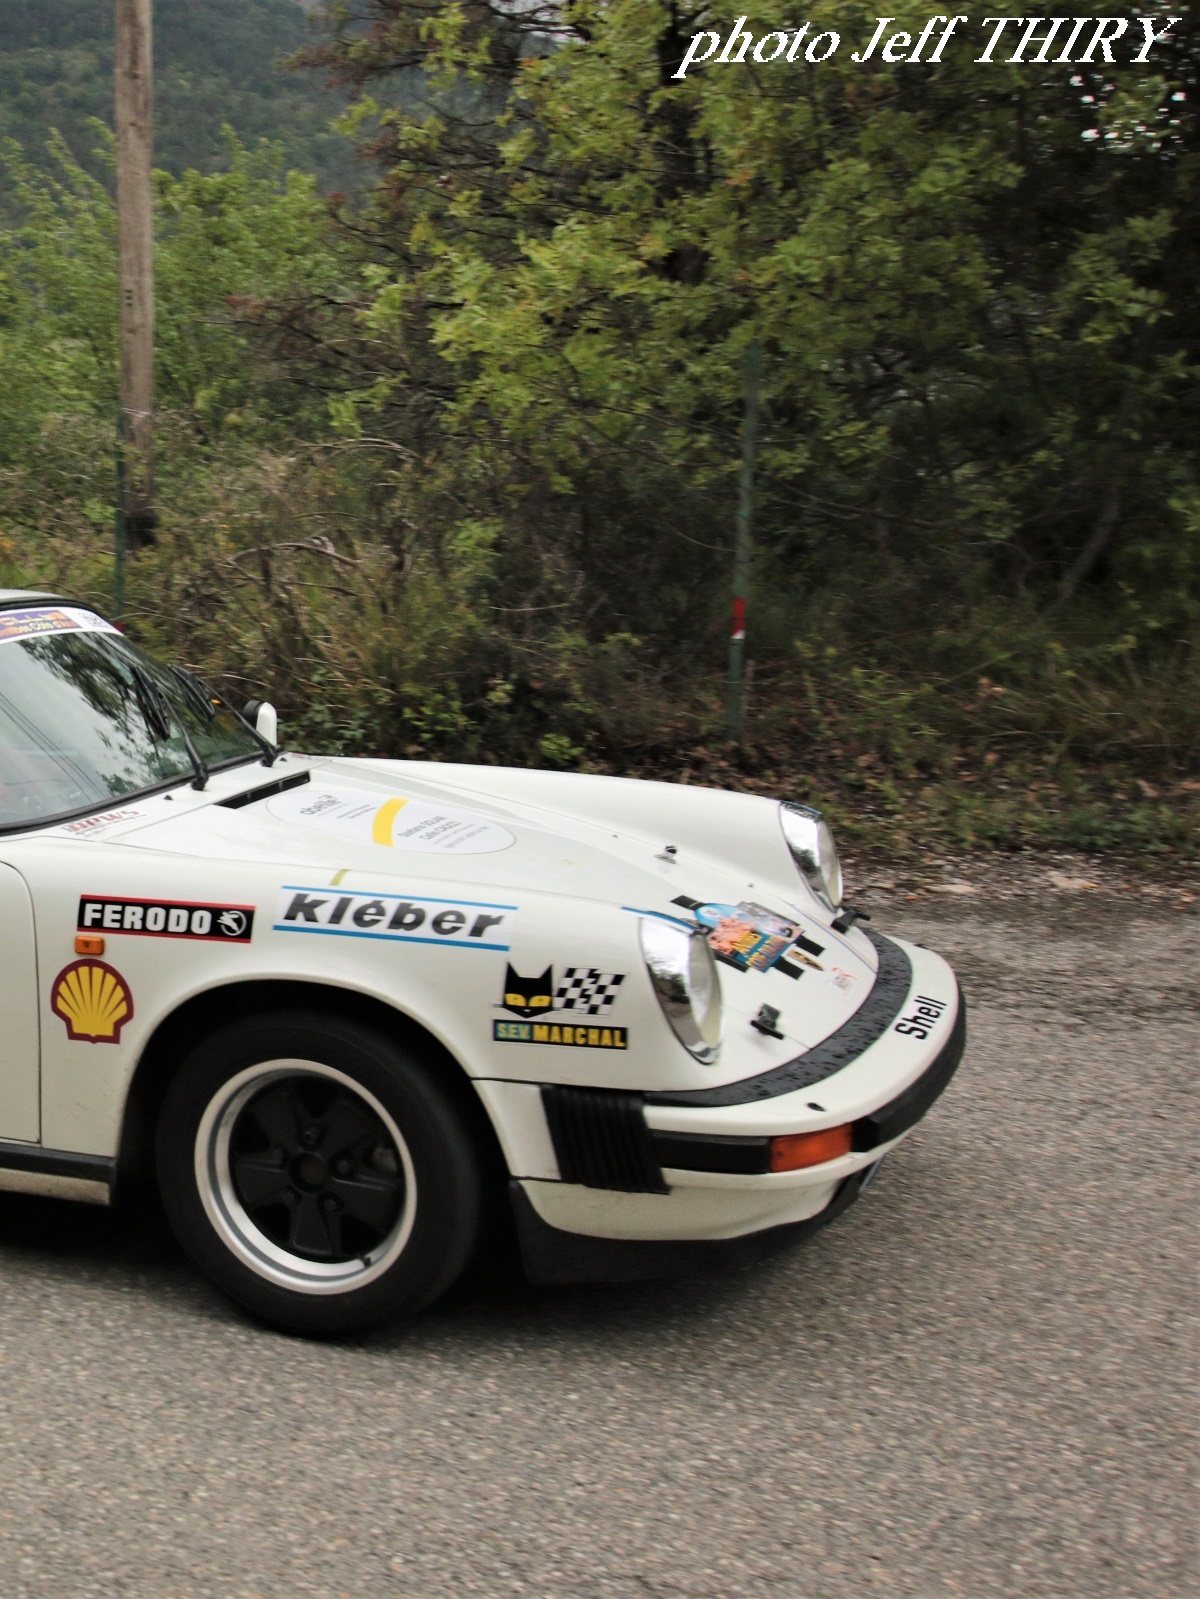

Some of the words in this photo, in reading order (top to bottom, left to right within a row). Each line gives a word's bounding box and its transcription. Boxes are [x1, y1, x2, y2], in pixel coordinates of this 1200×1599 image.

[83, 903, 213, 935] FERODO
[283, 893, 505, 938] kléber
[532, 1024, 627, 1047] MARCHAL
[894, 995, 947, 1040] Shell
